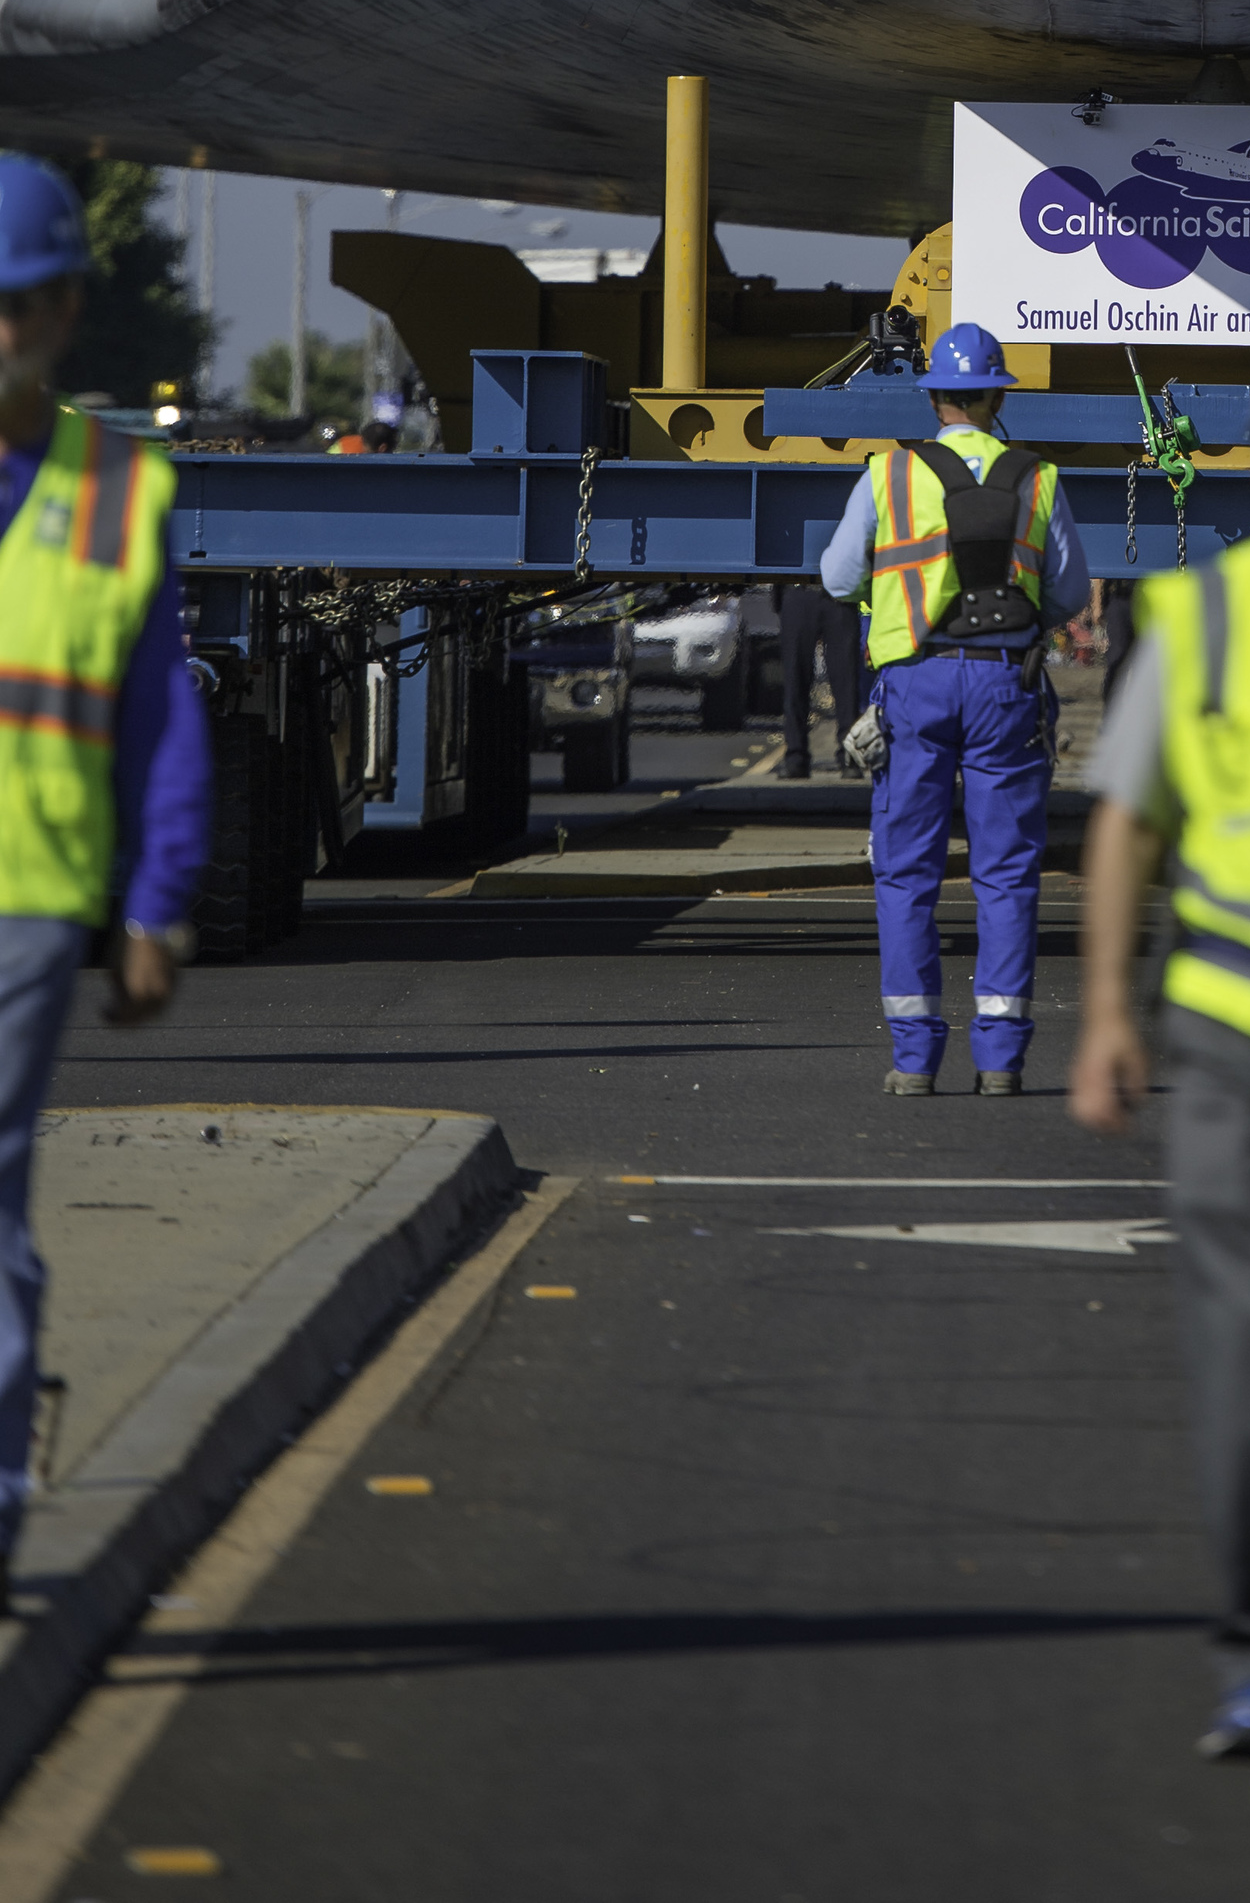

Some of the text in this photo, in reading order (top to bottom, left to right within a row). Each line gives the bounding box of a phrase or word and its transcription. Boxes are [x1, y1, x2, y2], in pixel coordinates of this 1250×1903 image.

[1016, 299, 1099, 331] Samuel
[1107, 300, 1179, 332] Oschin
[1187, 302, 1217, 332] Air
